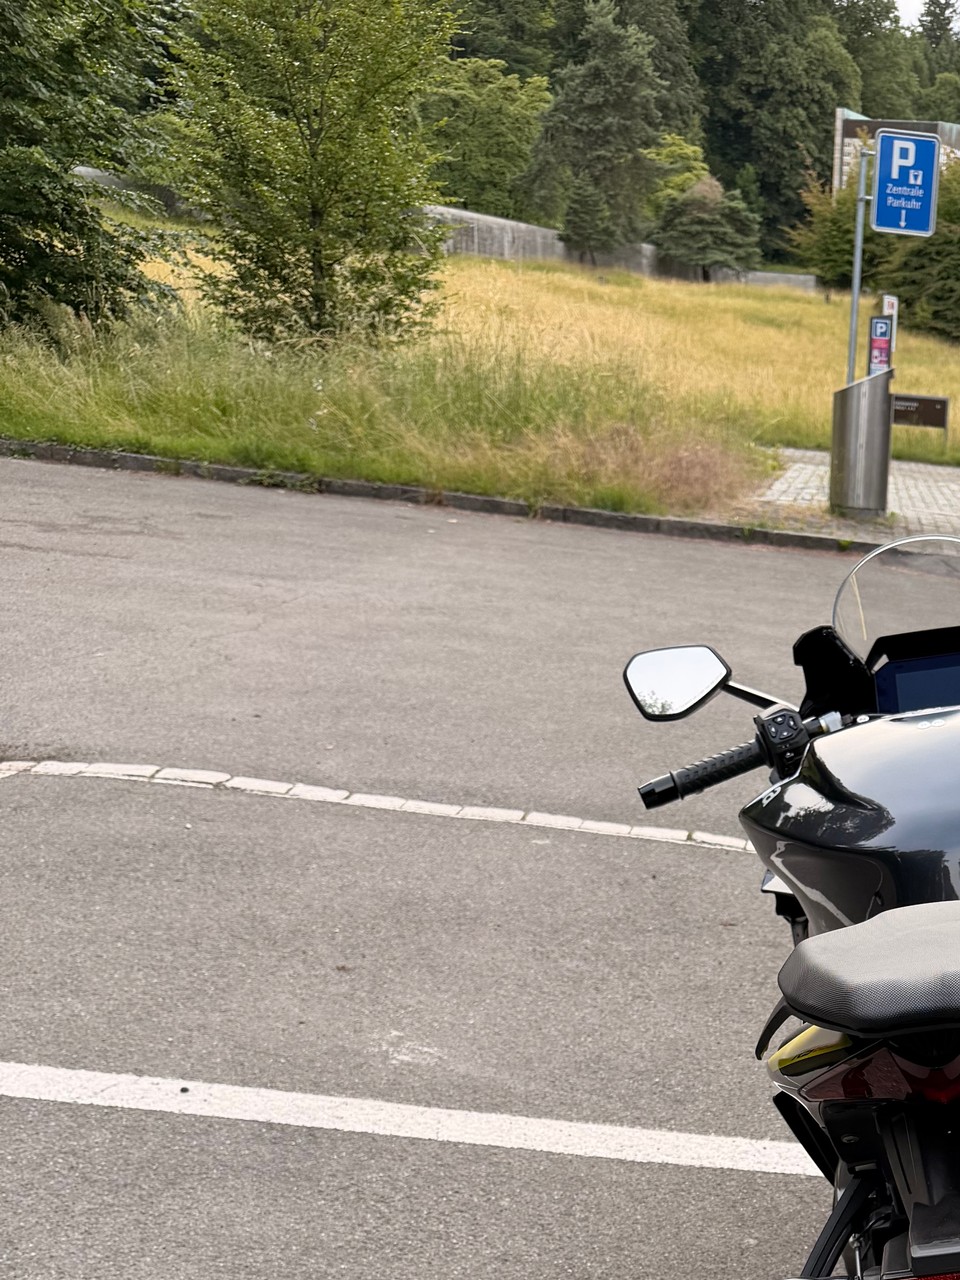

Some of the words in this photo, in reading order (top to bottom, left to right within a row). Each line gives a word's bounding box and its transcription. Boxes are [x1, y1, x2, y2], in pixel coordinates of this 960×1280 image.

[891, 140, 916, 180] P
[886, 183, 924, 197] Zentrale
[887, 196, 922, 209] Parkuhr
[876, 322, 887, 337] P
